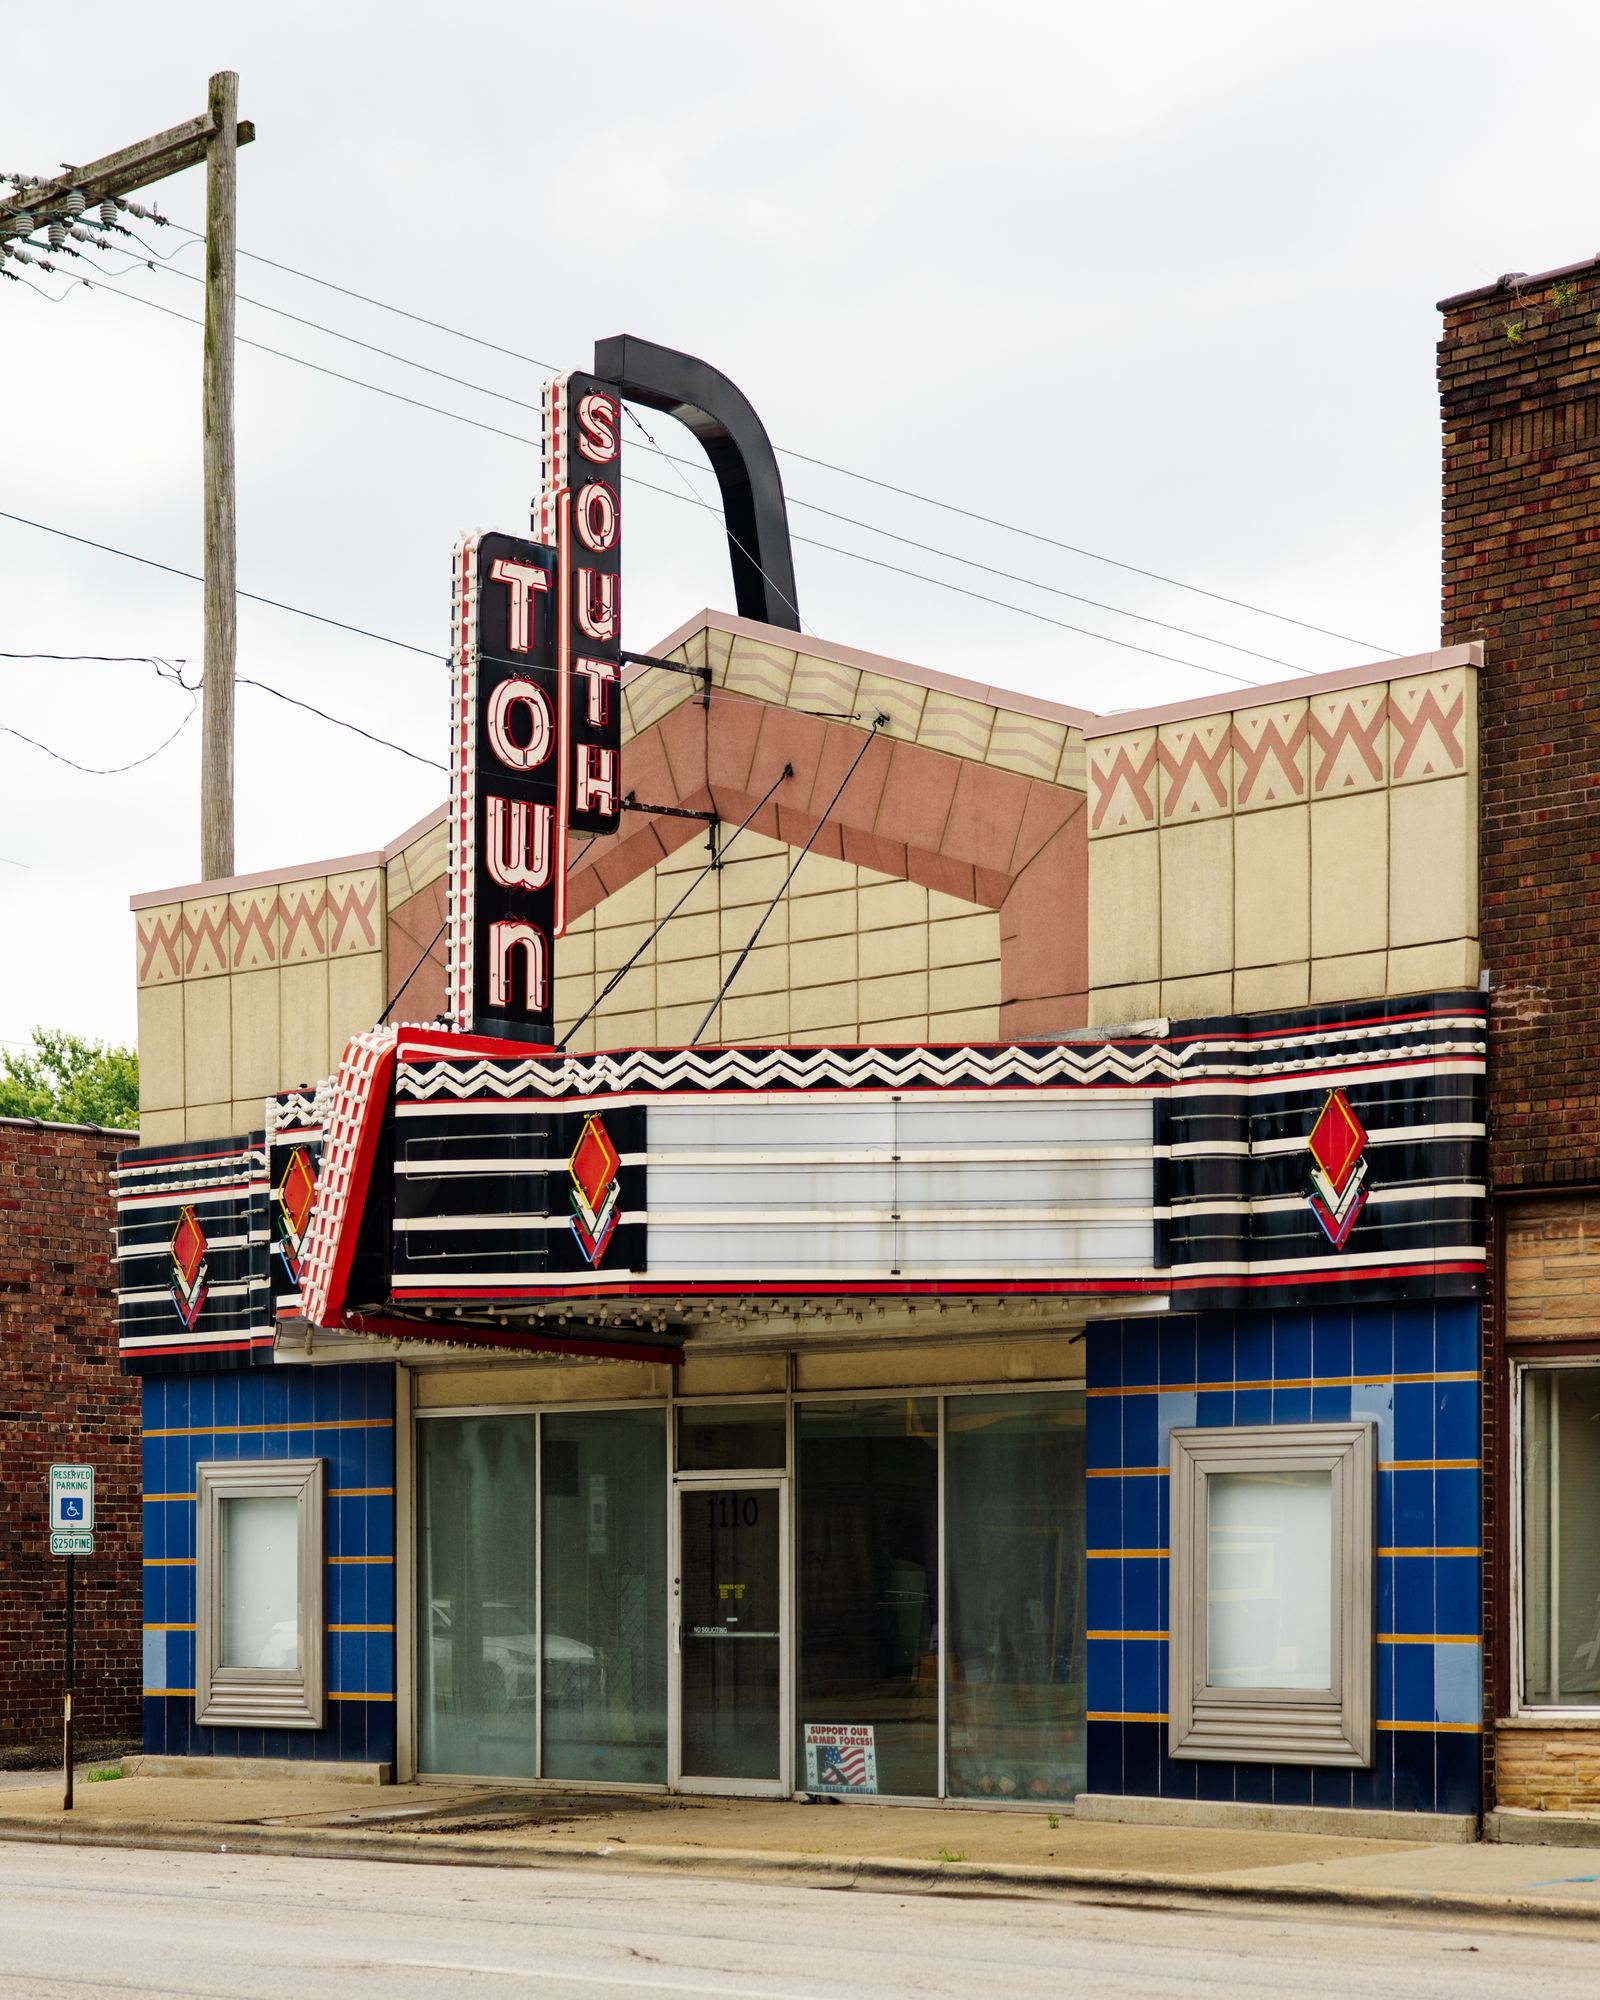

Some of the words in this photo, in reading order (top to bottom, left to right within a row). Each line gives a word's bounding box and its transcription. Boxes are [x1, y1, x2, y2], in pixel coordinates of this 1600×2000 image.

[575, 394, 621, 816] SOUTH
[53, 1470, 91, 1479] RESERVED
[56, 1481, 88, 1490] PARKING
[707, 1496, 759, 1528] 1110
[53, 1538, 74, 1549] $250
[74, 1538, 91, 1549] FINE
[810, 1726, 848, 1736] SUPPORT
[850, 1727, 869, 1736] OUR
[806, 1736, 837, 1745] ARMED
[840, 1737, 873, 1746] FORCES!
